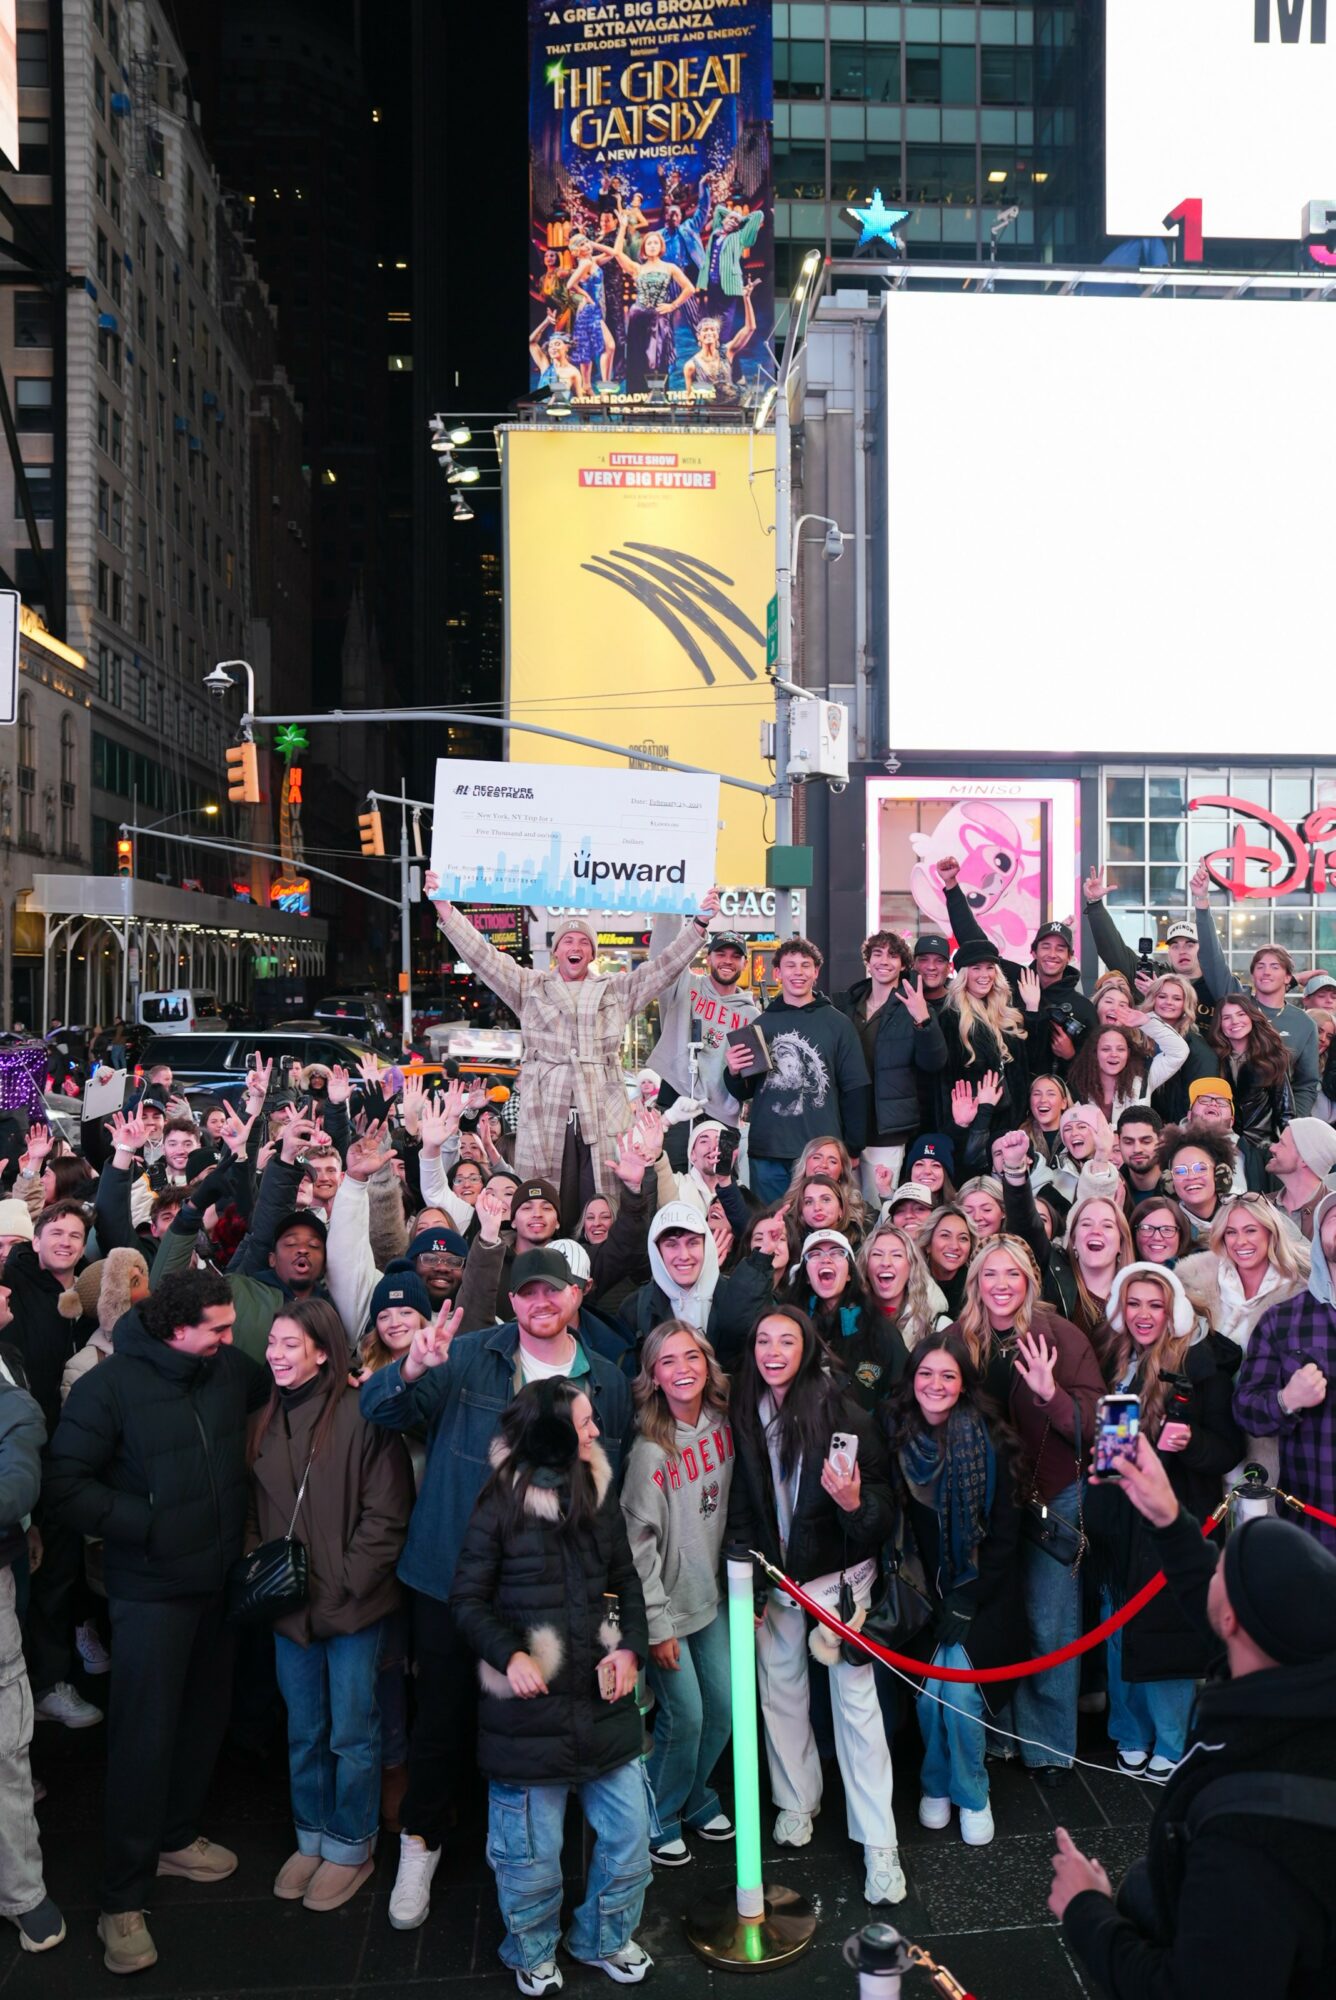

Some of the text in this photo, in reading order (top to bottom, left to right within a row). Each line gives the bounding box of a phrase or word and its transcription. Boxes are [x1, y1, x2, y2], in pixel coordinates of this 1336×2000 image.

[563, 5, 620, 23] GREAT,
[624, 1, 653, 18] BIG
[584, 13, 714, 38] EXTRAVAGANZA
[545, 43, 571, 56] THAT
[574, 38, 627, 53] EXPLODES
[629, 35, 656, 47] WITH
[658, 33, 680, 45] LIFE
[682, 30, 705, 42] AND
[549, 53, 748, 110] THE GREAT
[570, 97, 723, 150] GATSBY
[595, 143, 697, 163] A NEW MUSICAL
[611, 454, 644, 465] LITTLE
[645, 455, 676, 465] SHOW
[583, 471, 712, 488] VERY BIG FUTURE
[472, 791, 534, 800] LIVESTREAM
[474, 785, 533, 794] RECAPTURE
[949, 785, 1022, 795] MINISO
[467, 912, 516, 929] LECTRONICS
[597, 933, 634, 945] Nikon
[690, 990, 749, 1030] PHOENI
[652, 1424, 734, 1491] PHOENI
